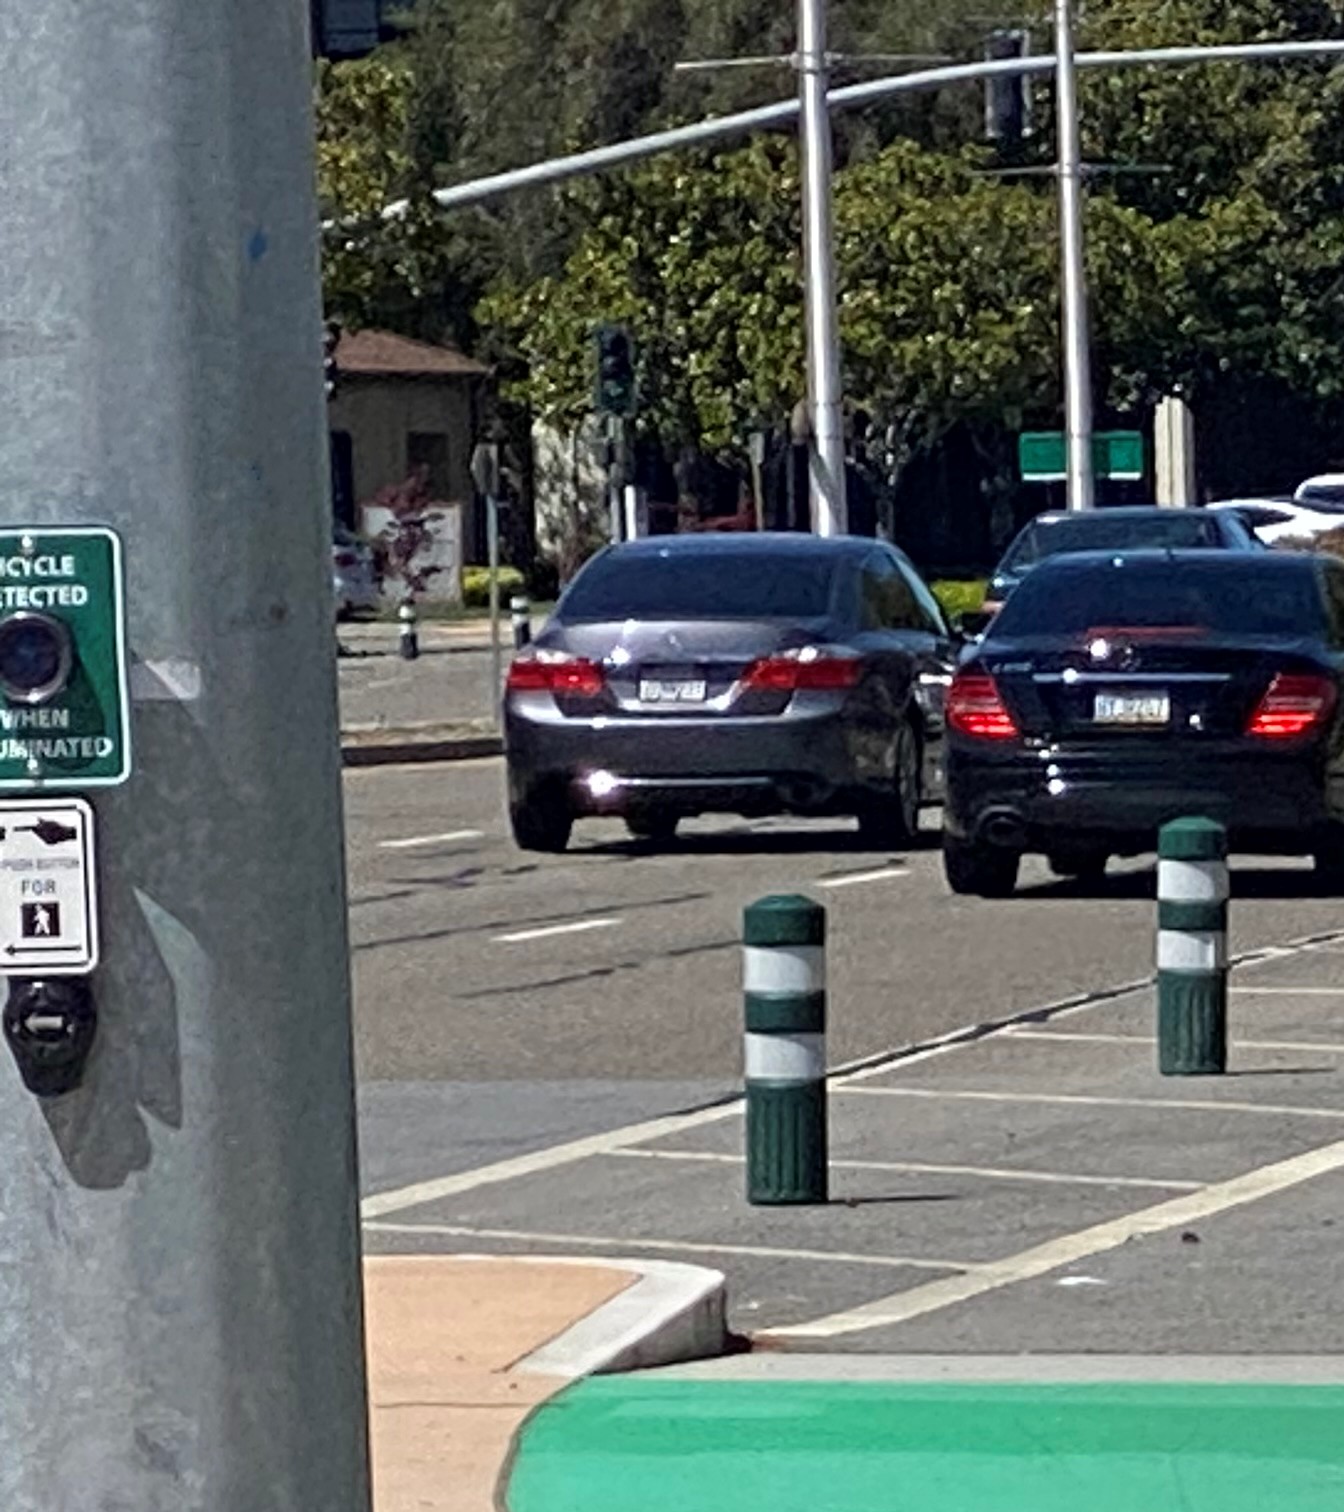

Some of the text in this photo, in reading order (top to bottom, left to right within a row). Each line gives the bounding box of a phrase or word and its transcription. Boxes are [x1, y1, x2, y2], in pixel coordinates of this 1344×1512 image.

[0, 585, 88, 608] TECTED
[0, 708, 69, 730] WHEN
[21, 877, 56, 896] FOR
